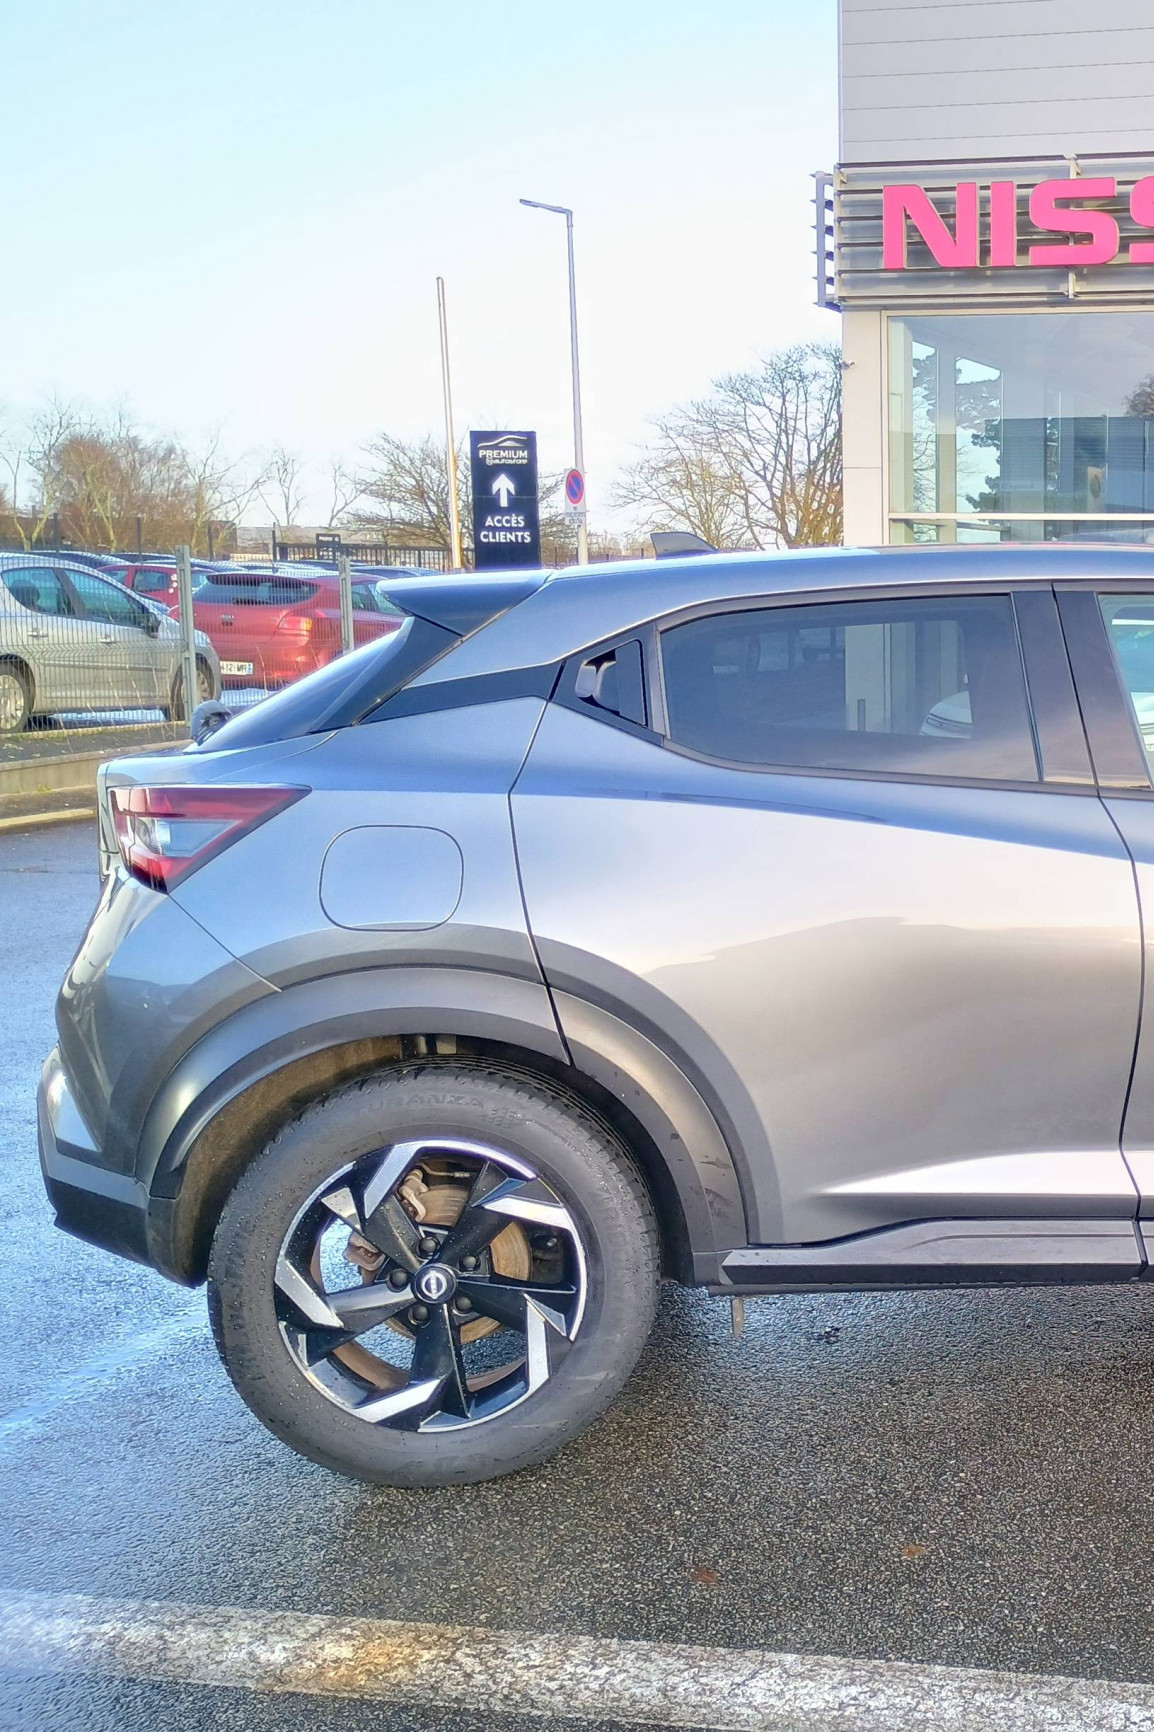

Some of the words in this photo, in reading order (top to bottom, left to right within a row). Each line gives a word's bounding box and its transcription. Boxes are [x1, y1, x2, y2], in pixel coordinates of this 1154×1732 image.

[479, 450, 528, 458] PREMIUM
[485, 514, 525, 527] ACCÈS
[480, 531, 531, 543] CLIENTS
